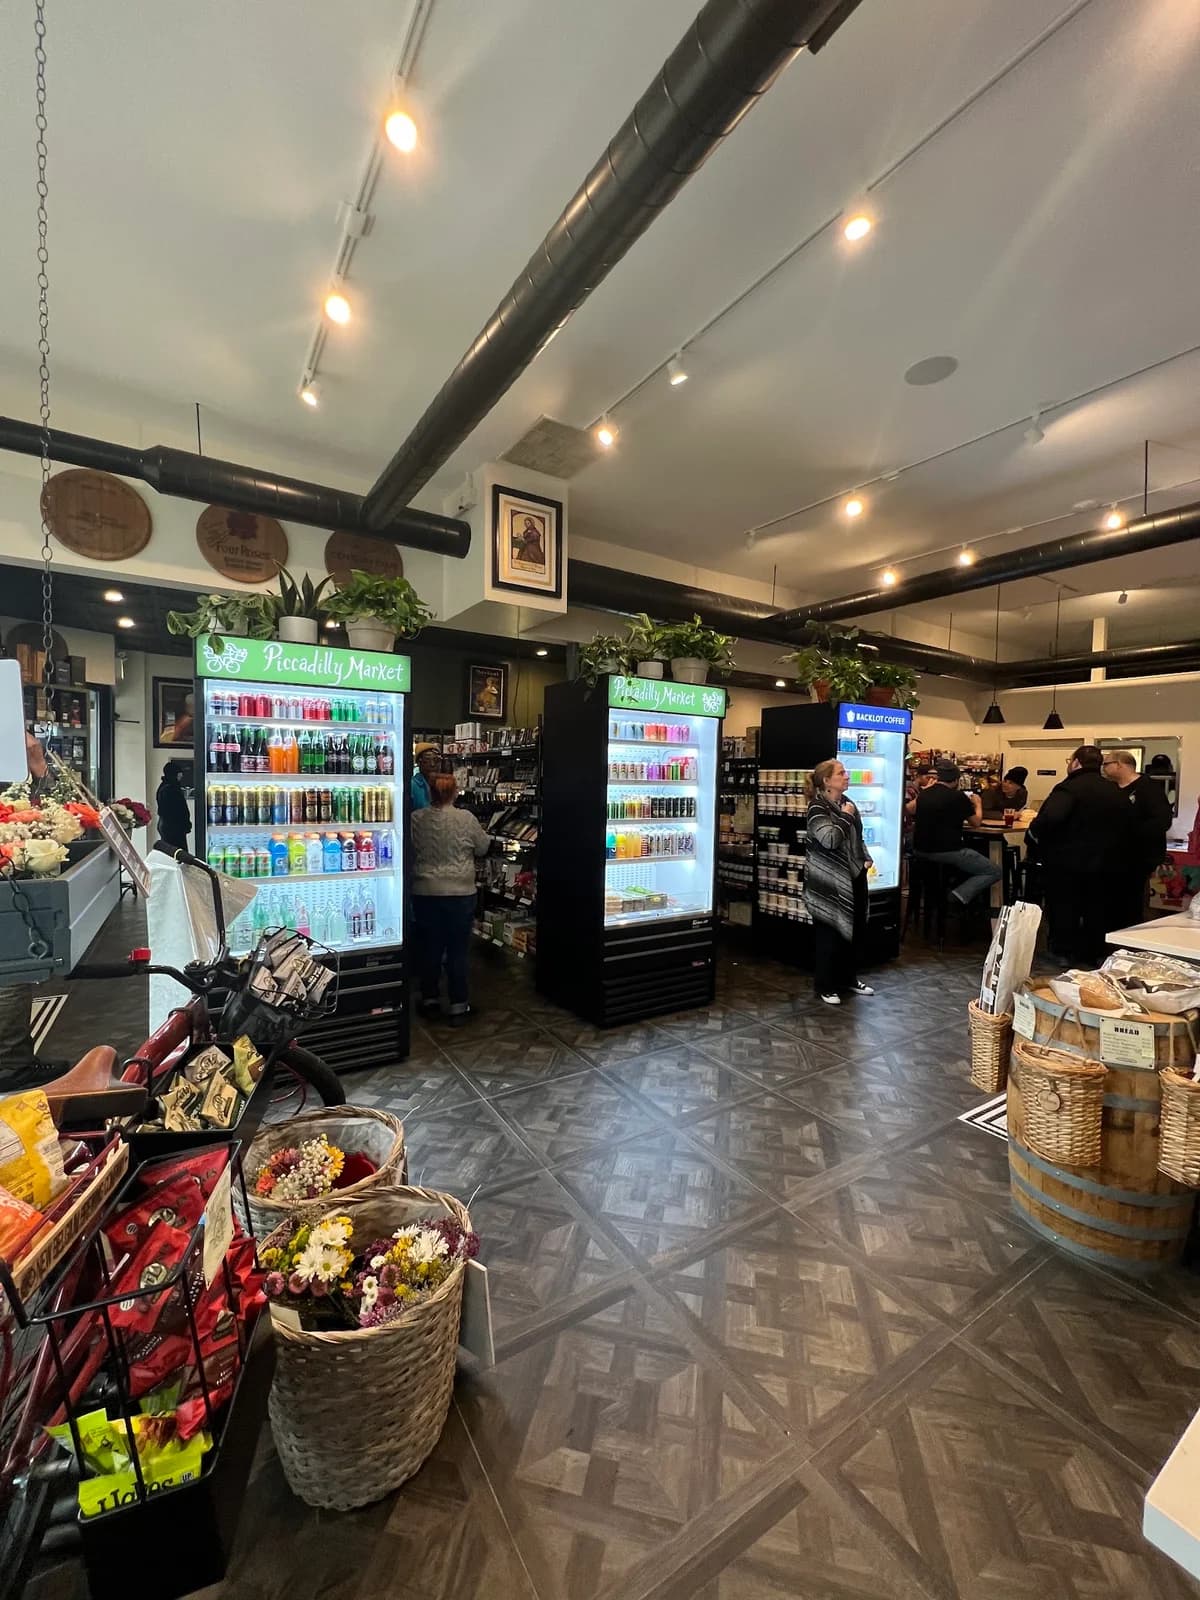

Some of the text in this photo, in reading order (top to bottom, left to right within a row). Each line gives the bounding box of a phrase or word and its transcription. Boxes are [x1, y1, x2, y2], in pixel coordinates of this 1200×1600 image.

[263, 643, 404, 686] Piccadilly Market
[660, 687, 696, 706] Market
[856, 713, 905, 725] BACKLOT COFFEE
